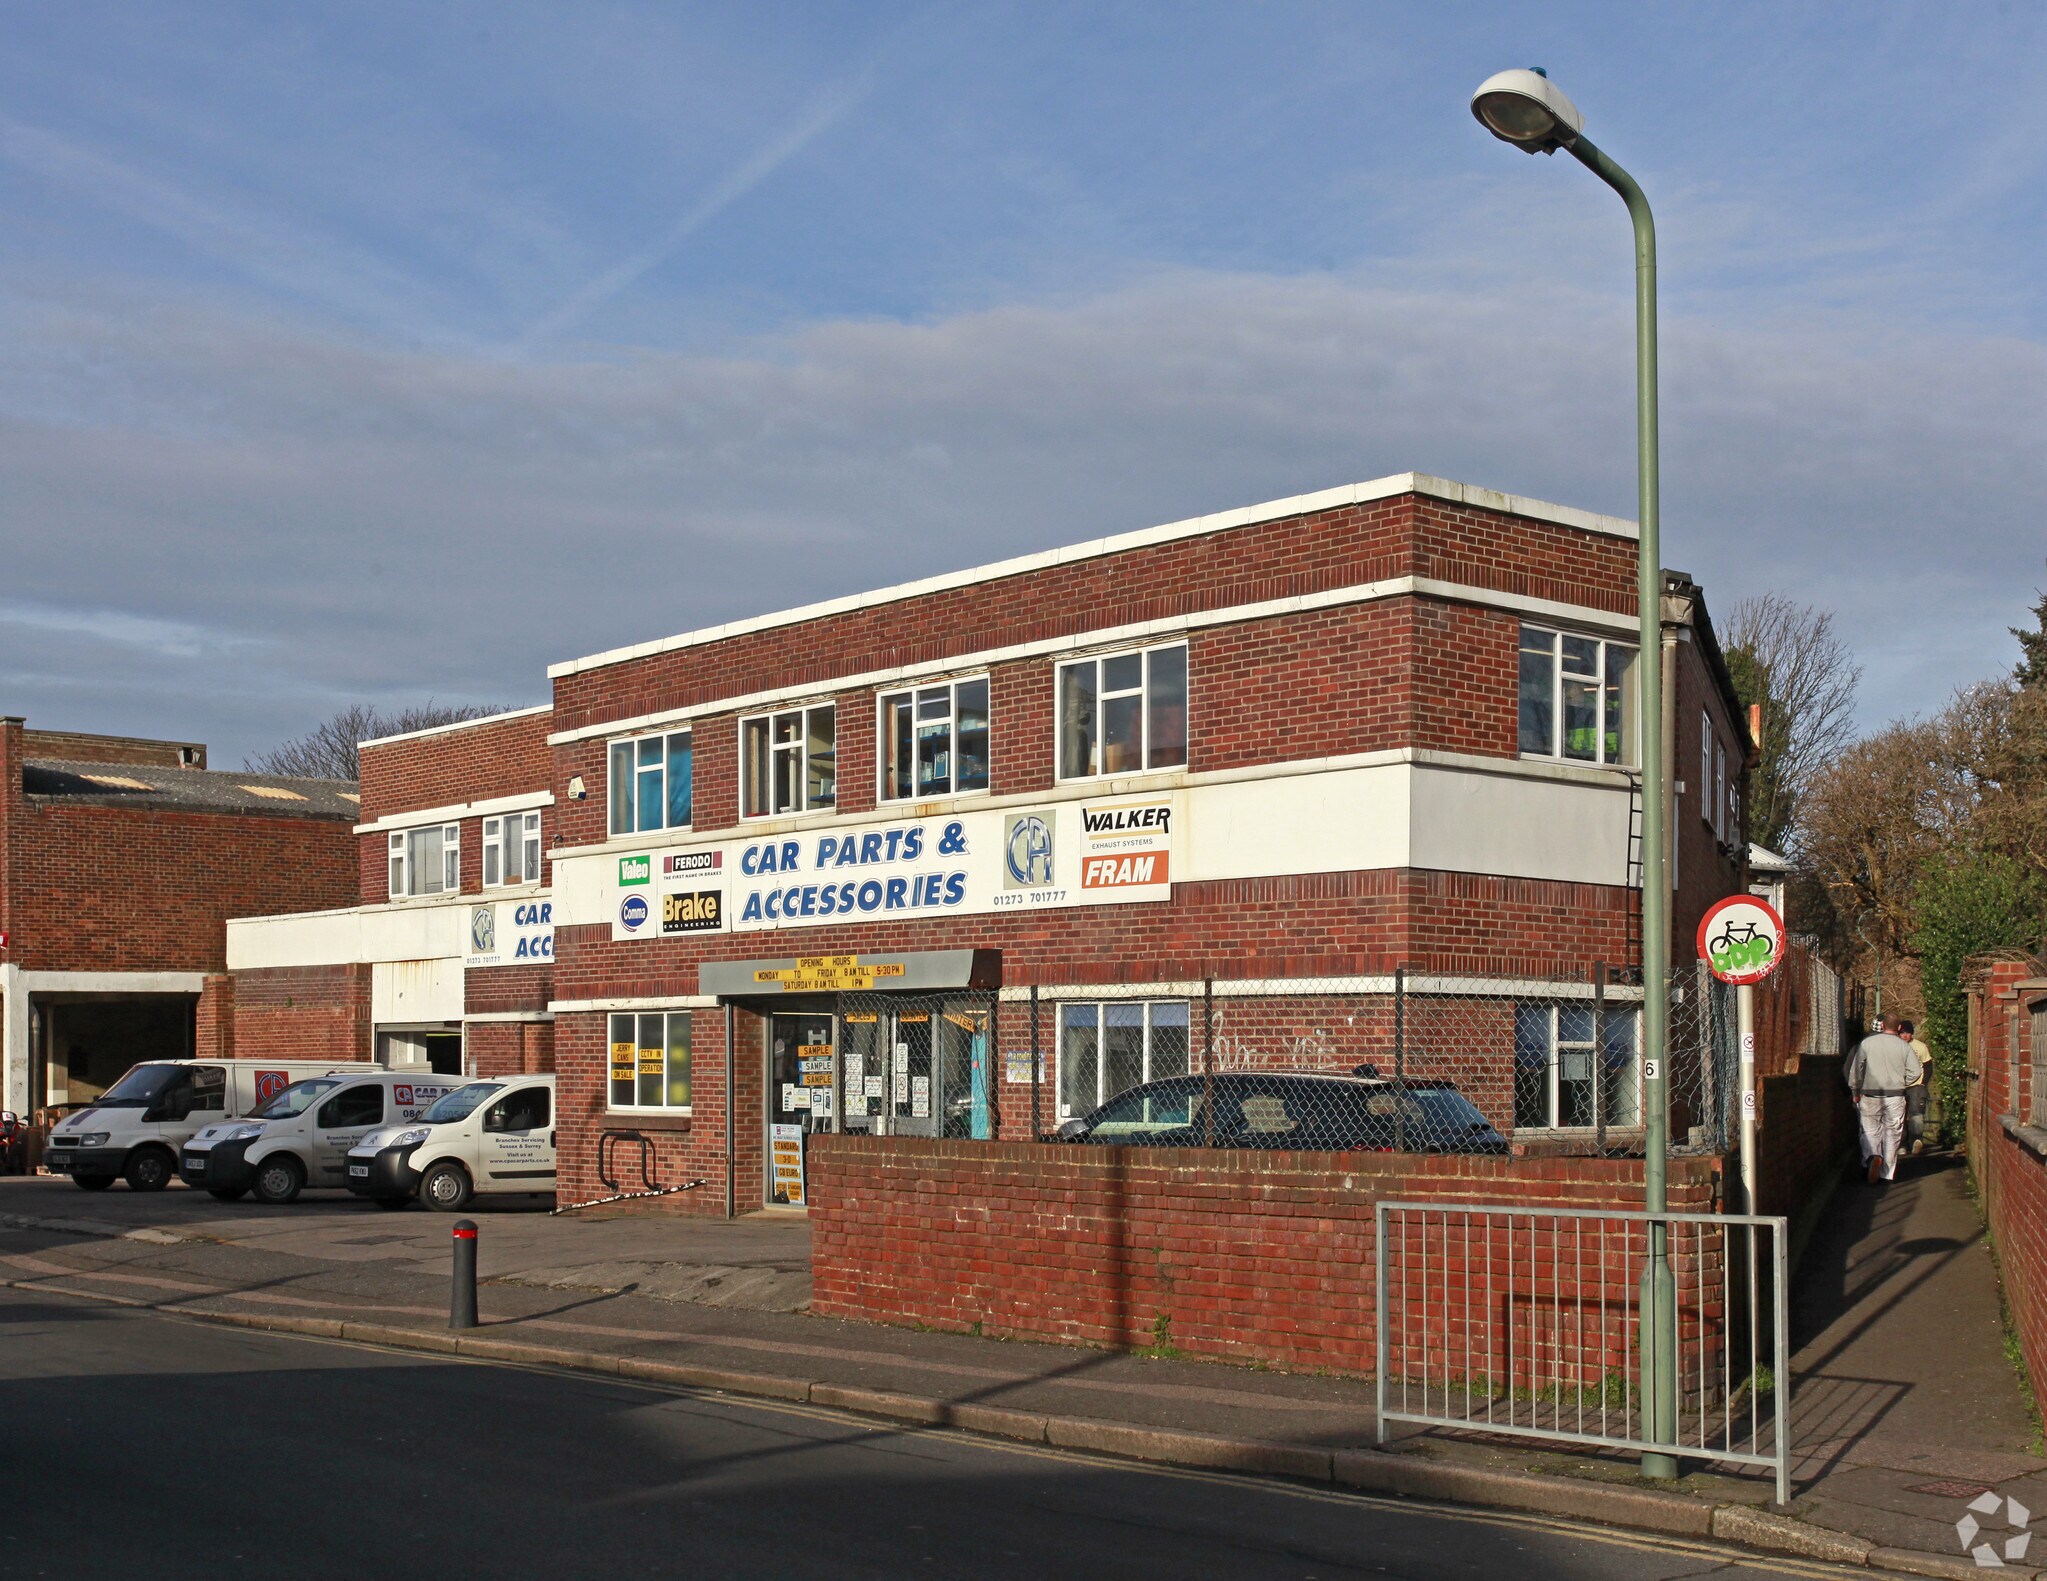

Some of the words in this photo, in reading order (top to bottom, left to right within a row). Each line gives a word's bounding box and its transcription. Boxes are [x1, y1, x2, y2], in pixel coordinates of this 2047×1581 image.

[1082, 807, 1171, 834] WALKER
[740, 840, 801, 877] CAR
[814, 825, 926, 871] PARTS
[937, 820, 970, 857] &
[1091, 841, 1121, 850] EXHAUST
[1122, 838, 1154, 847] SYSTEMS
[675, 854, 711, 870] FERODO
[621, 860, 649, 880] Valeo
[1085, 856, 1155, 887] FRAM
[739, 870, 968, 923] ACCESSORIES
[993, 893, 1023, 906] 01273
[1030, 890, 1067, 904] 701777
[623, 905, 646, 920] Comma
[663, 892, 717, 922] Brake
[514, 902, 553, 926] CAR
[663, 921, 720, 929] ENGINEERING
[800, 957, 824, 968] OPENING
[832, 956, 851, 966] HOURS
[758, 971, 779, 980] MONDAY
[793, 970, 801, 979] TO
[817, 968, 837, 977] FRIDAY
[784, 980, 811, 990] SATURDAY
[616, 1044, 631, 1052] JERRY
[641, 1050, 652, 1058] CCTV
[804, 1046, 829, 1054] SAMPLE
[639, 1064, 663, 1072] OPERATION
[806, 1061, 831, 1070] SAMPLE
[1645, 1062, 1654, 1076] 6
[807, 1075, 832, 1084] SAMPLE
[774, 1141, 799, 1151] STANDARD
